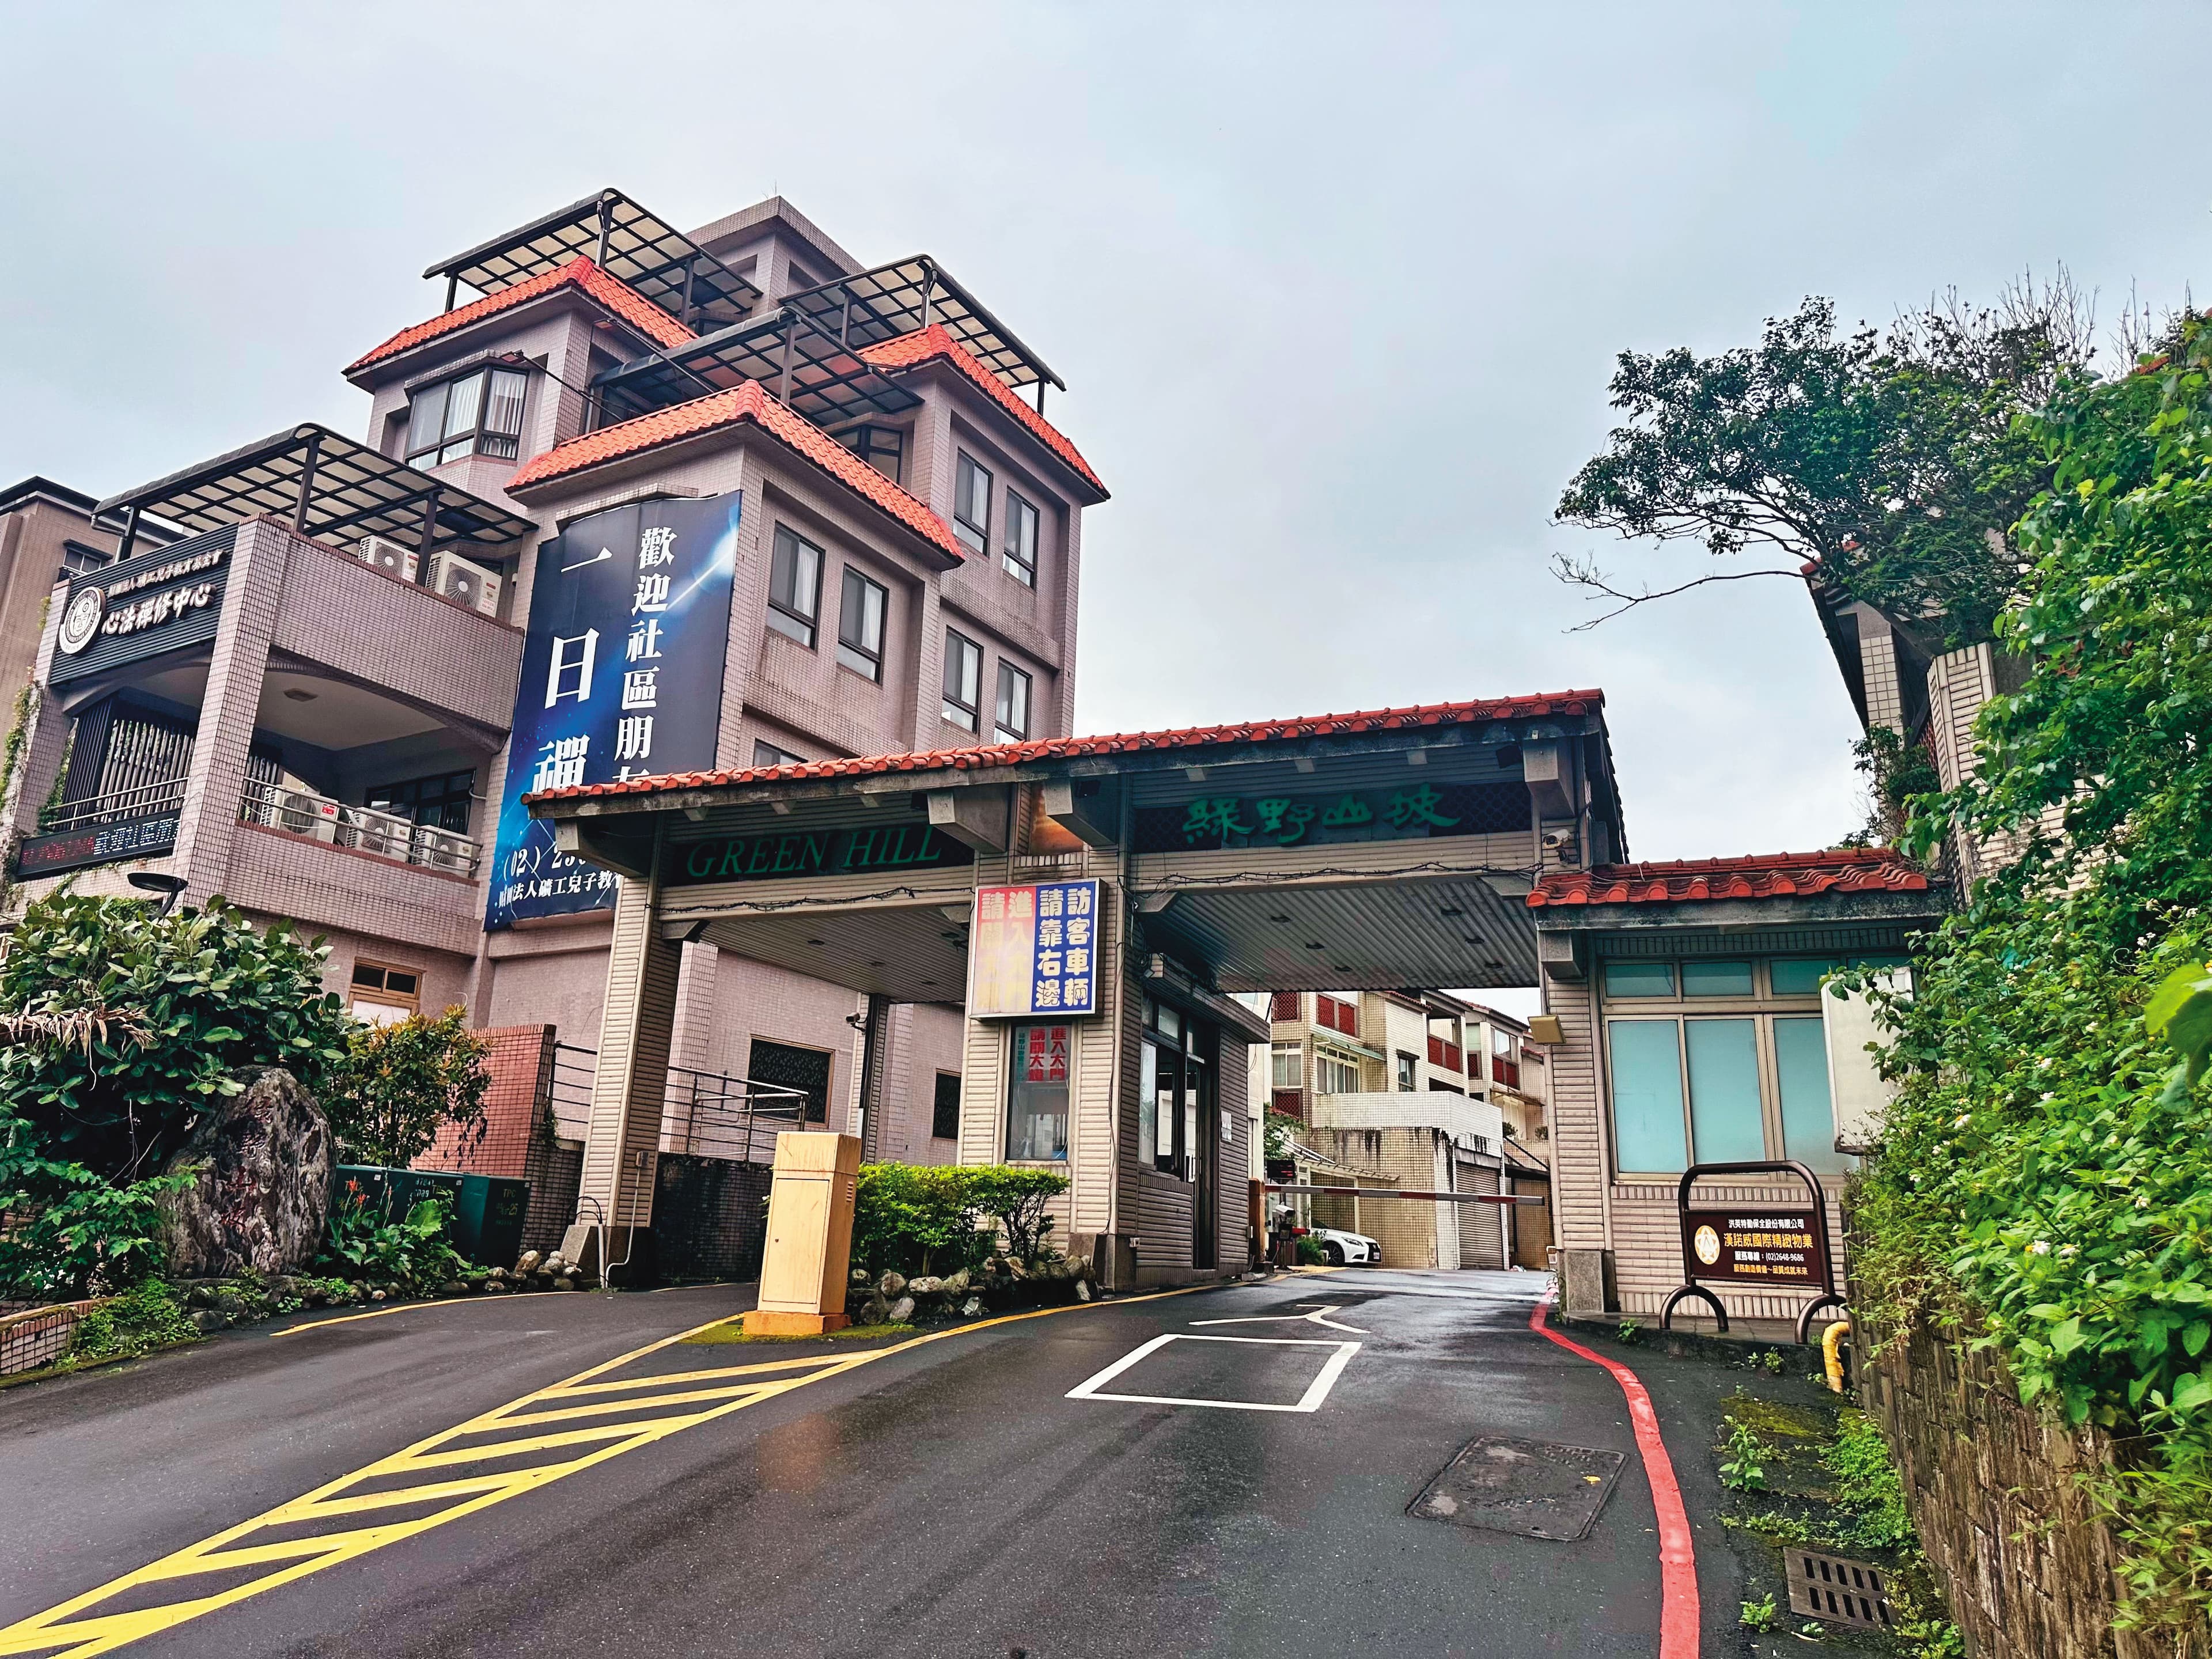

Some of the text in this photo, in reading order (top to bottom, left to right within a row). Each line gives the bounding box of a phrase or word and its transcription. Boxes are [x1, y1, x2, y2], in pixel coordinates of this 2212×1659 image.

[101, 583, 213, 635] 心法禪修中心
[532, 547, 612, 793] 一日禪
[1182, 782, 1461, 844] 綠野山坡
[687, 825, 942, 877] GREEN HILL
[1004, 891, 1033, 1007] 進入大門
[1035, 888, 1063, 1008] 請靠右邊
[1063, 887, 1092, 1007] 訪客車輛
[1050, 1027, 1066, 1081] 進入大門
[1723, 1233, 1814, 1249] 漢諾威國際精緻物業
